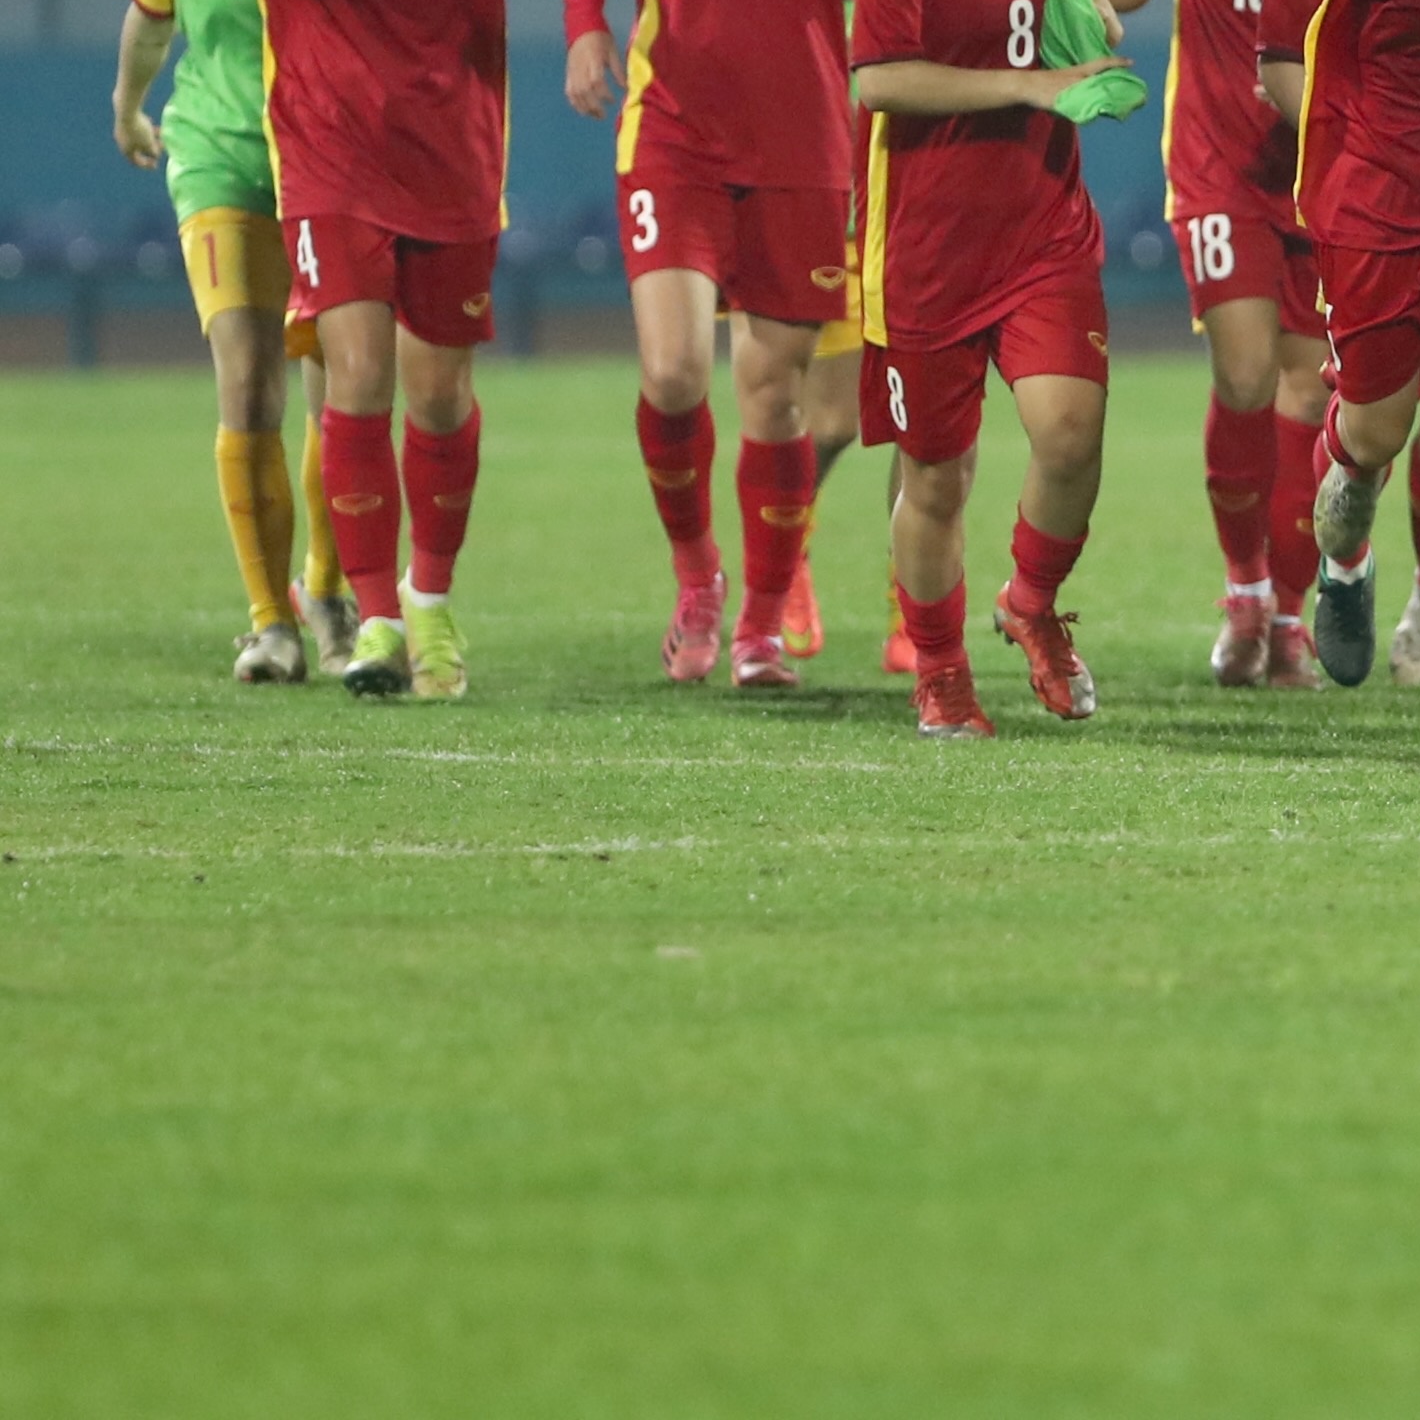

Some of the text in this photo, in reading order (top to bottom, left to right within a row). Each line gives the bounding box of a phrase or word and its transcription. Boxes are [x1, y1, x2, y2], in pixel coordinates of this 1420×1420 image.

[630, 190, 658, 252] 3
[1188, 214, 1234, 282] 18
[202, 232, 218, 289] 1
[297, 220, 319, 287] 4
[888, 367, 907, 431] 8
